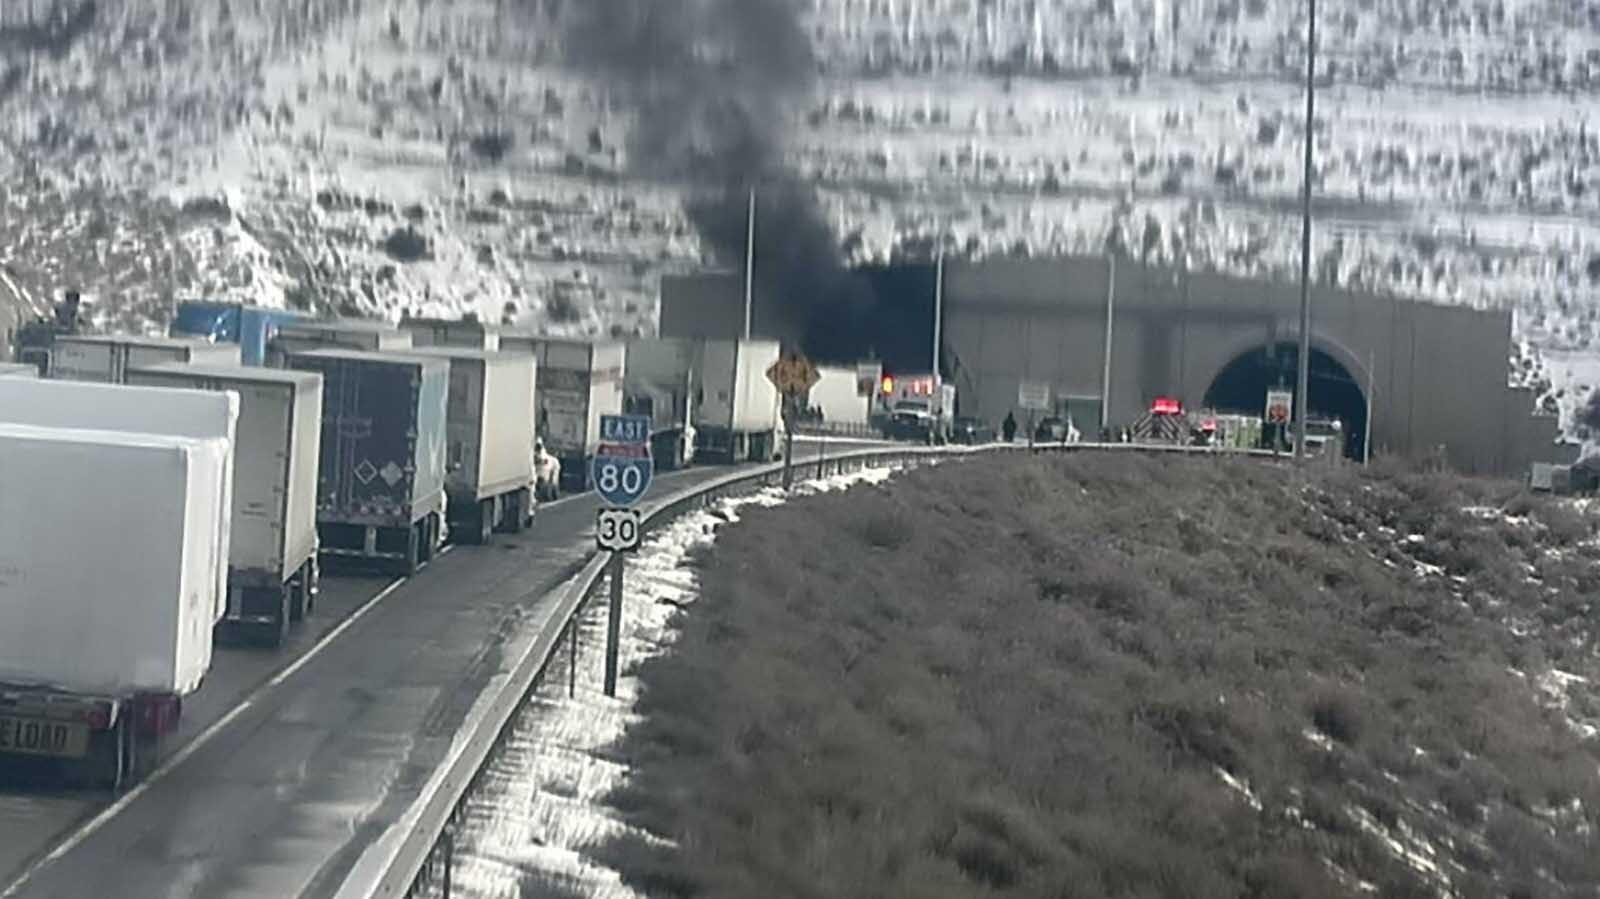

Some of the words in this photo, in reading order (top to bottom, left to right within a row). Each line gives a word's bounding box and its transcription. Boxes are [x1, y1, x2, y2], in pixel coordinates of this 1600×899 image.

[604, 419, 643, 440] EAST
[600, 463, 642, 494] 80
[602, 517, 635, 541] 30
